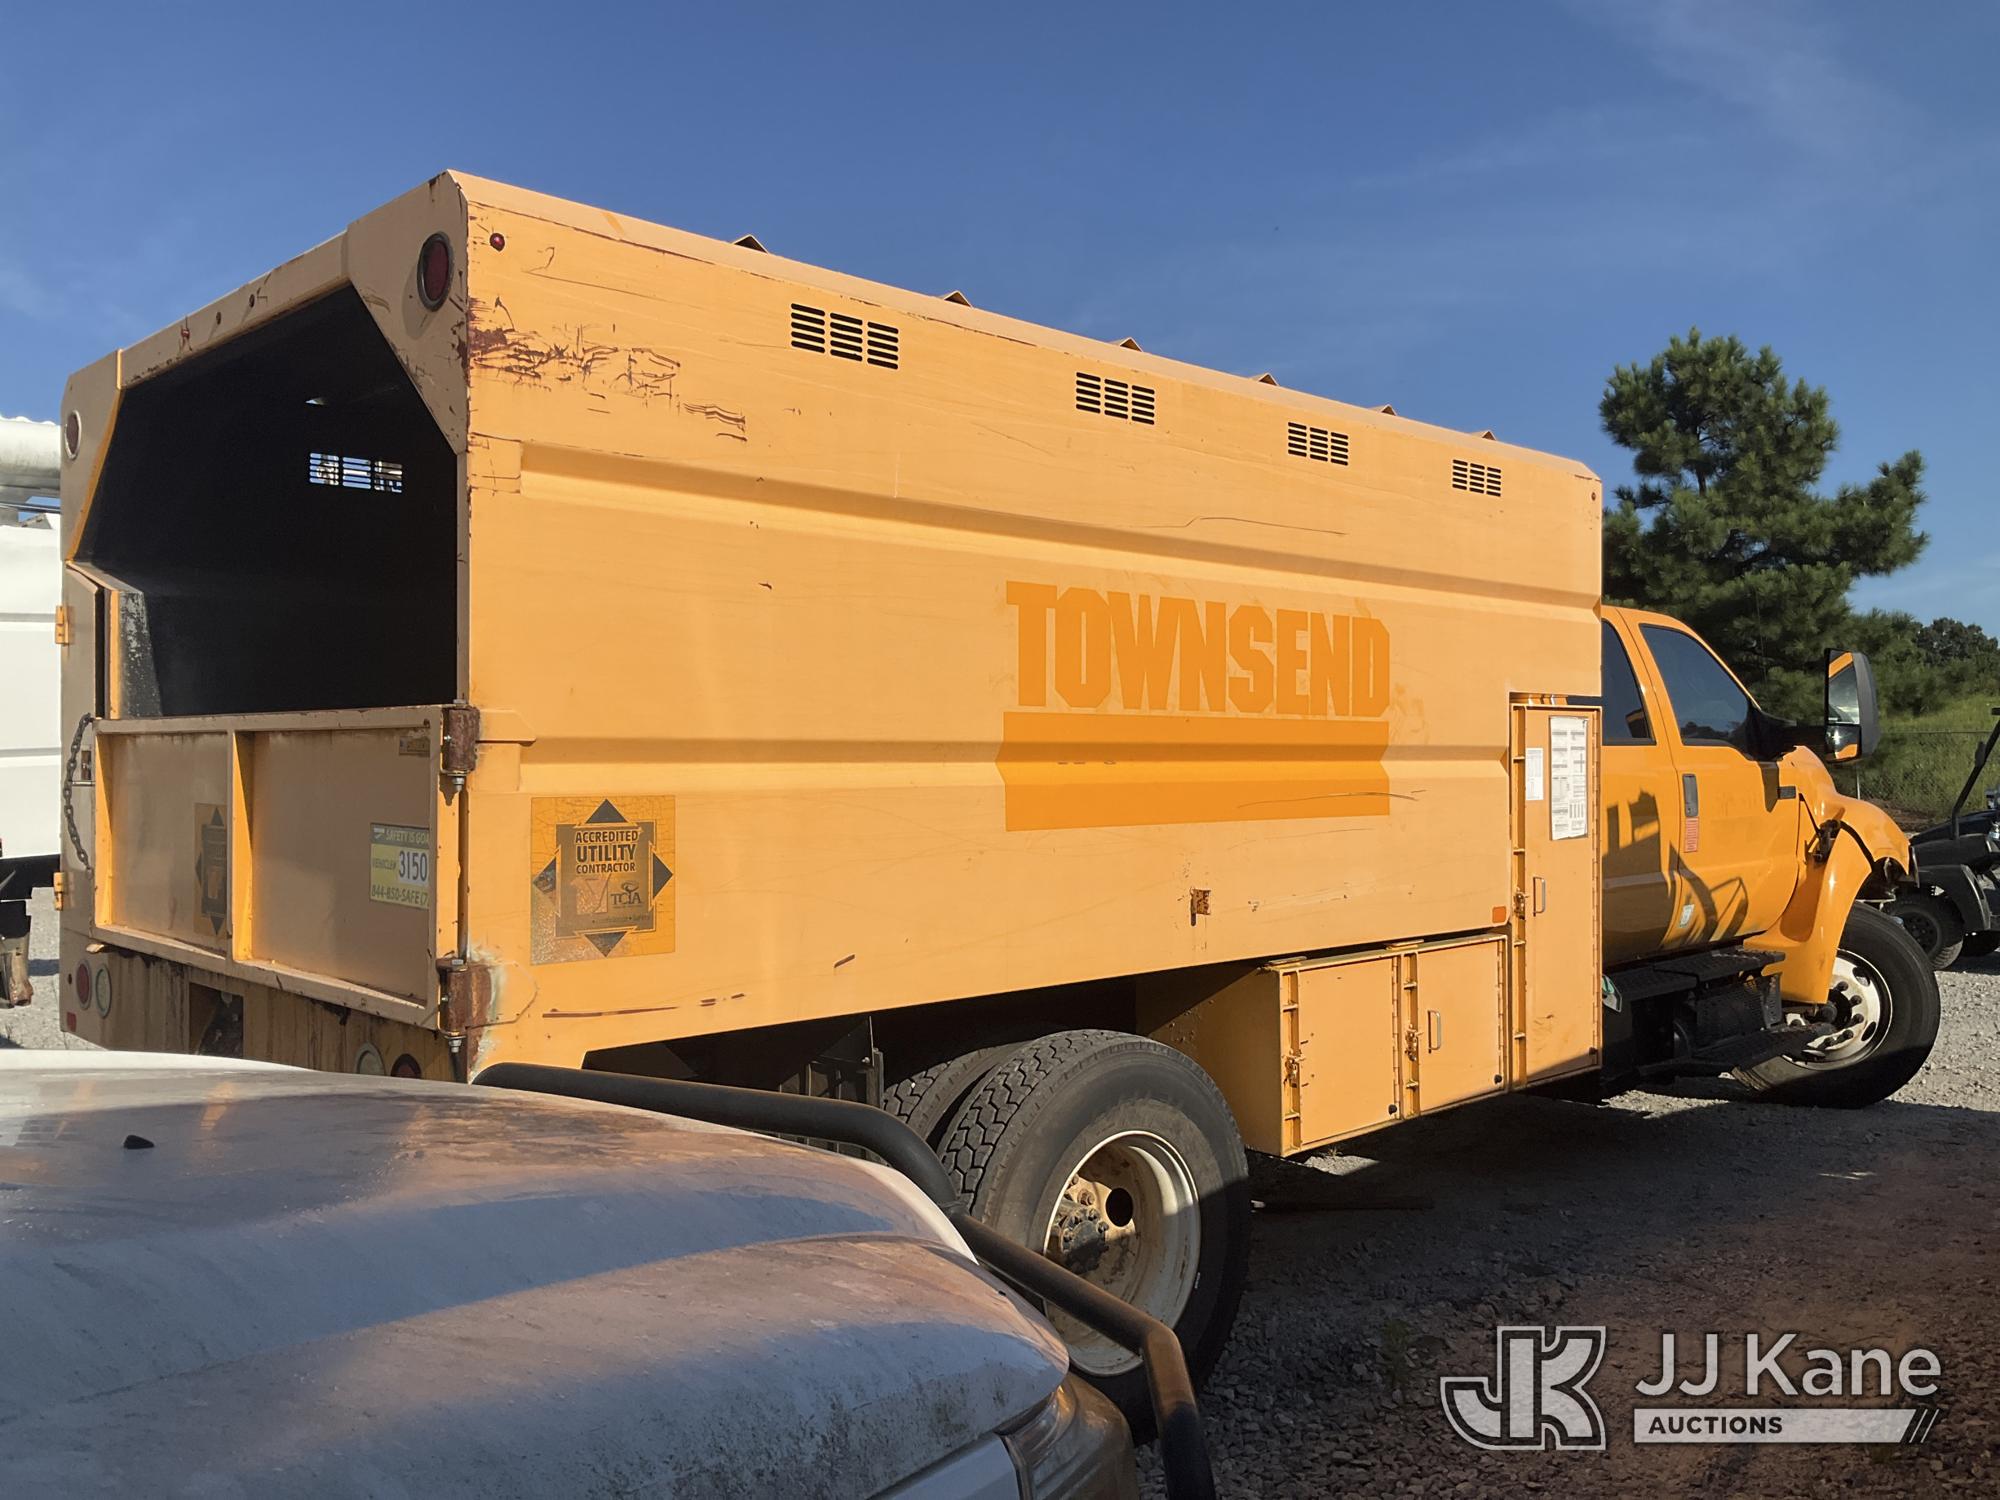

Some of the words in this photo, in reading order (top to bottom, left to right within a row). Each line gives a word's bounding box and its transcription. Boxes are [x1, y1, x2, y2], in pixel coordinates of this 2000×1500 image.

[1006, 580, 1391, 718] TOWNSEND
[575, 831, 638, 844] ACCREDITED
[577, 844, 636, 863] UTILITY
[399, 850, 428, 882] 3150
[576, 863, 636, 874] CONTRACTOR
